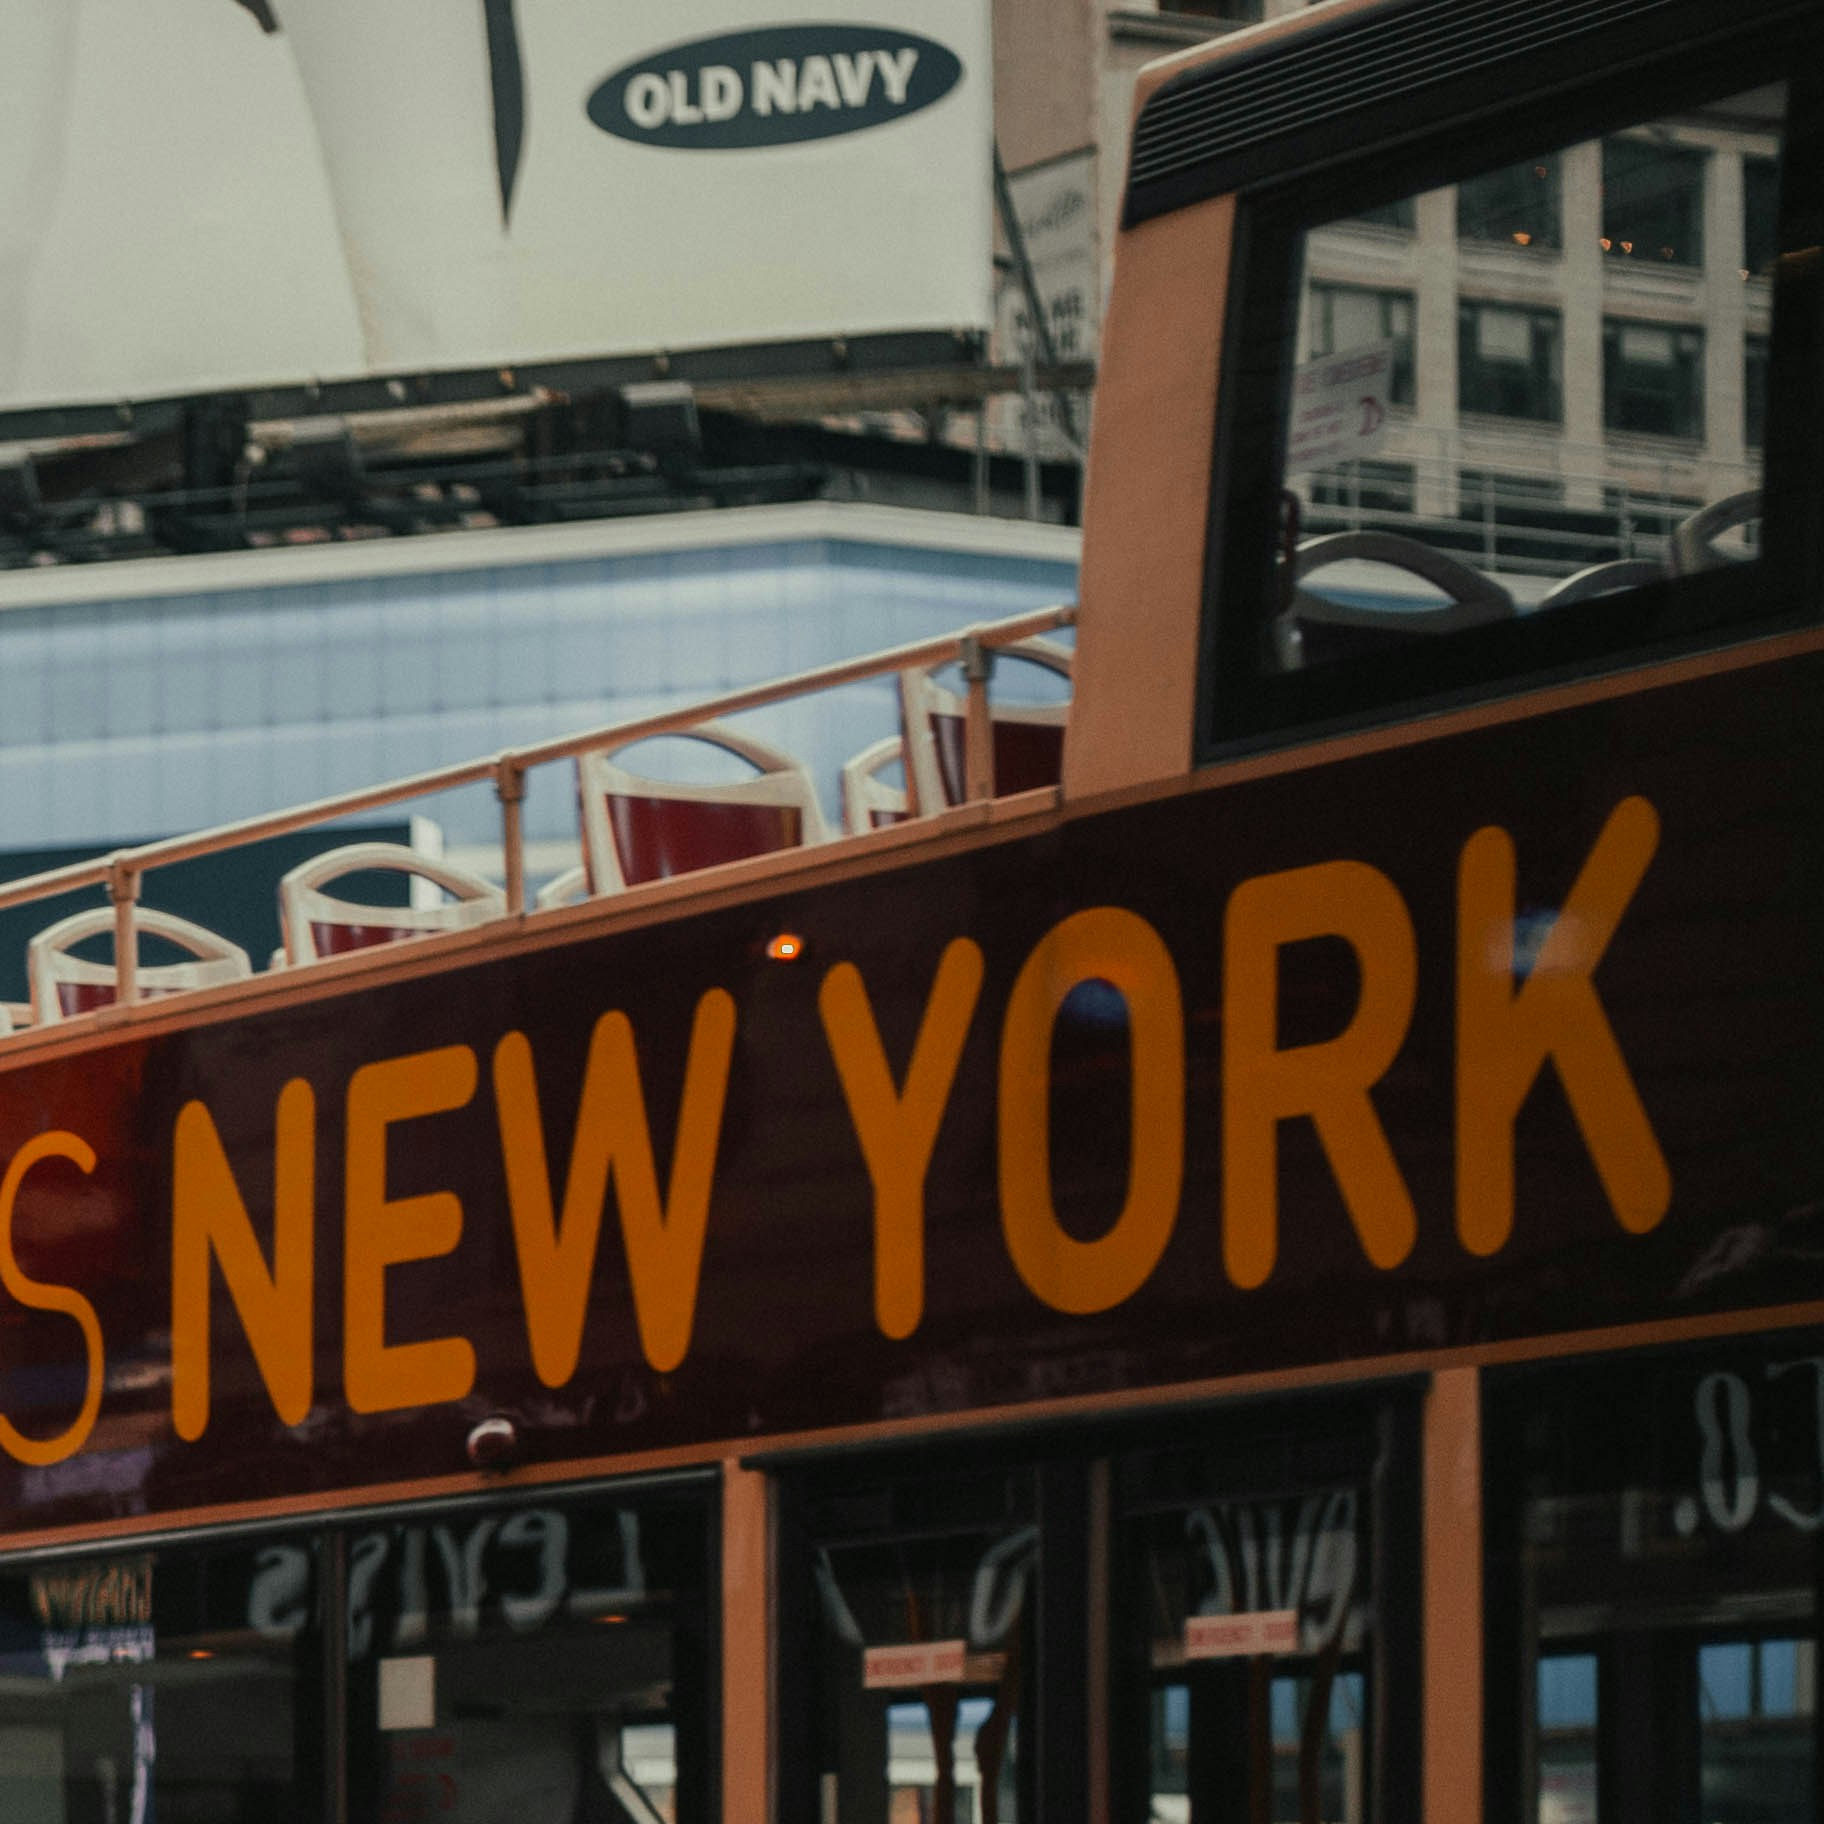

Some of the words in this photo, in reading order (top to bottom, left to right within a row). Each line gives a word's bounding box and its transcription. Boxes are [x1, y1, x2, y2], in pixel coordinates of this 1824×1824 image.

[624, 64, 743, 130] OLD
[752, 48, 920, 117] NAVY
[171, 989, 735, 1441] NEW
[821, 794, 1672, 1339] YORK
